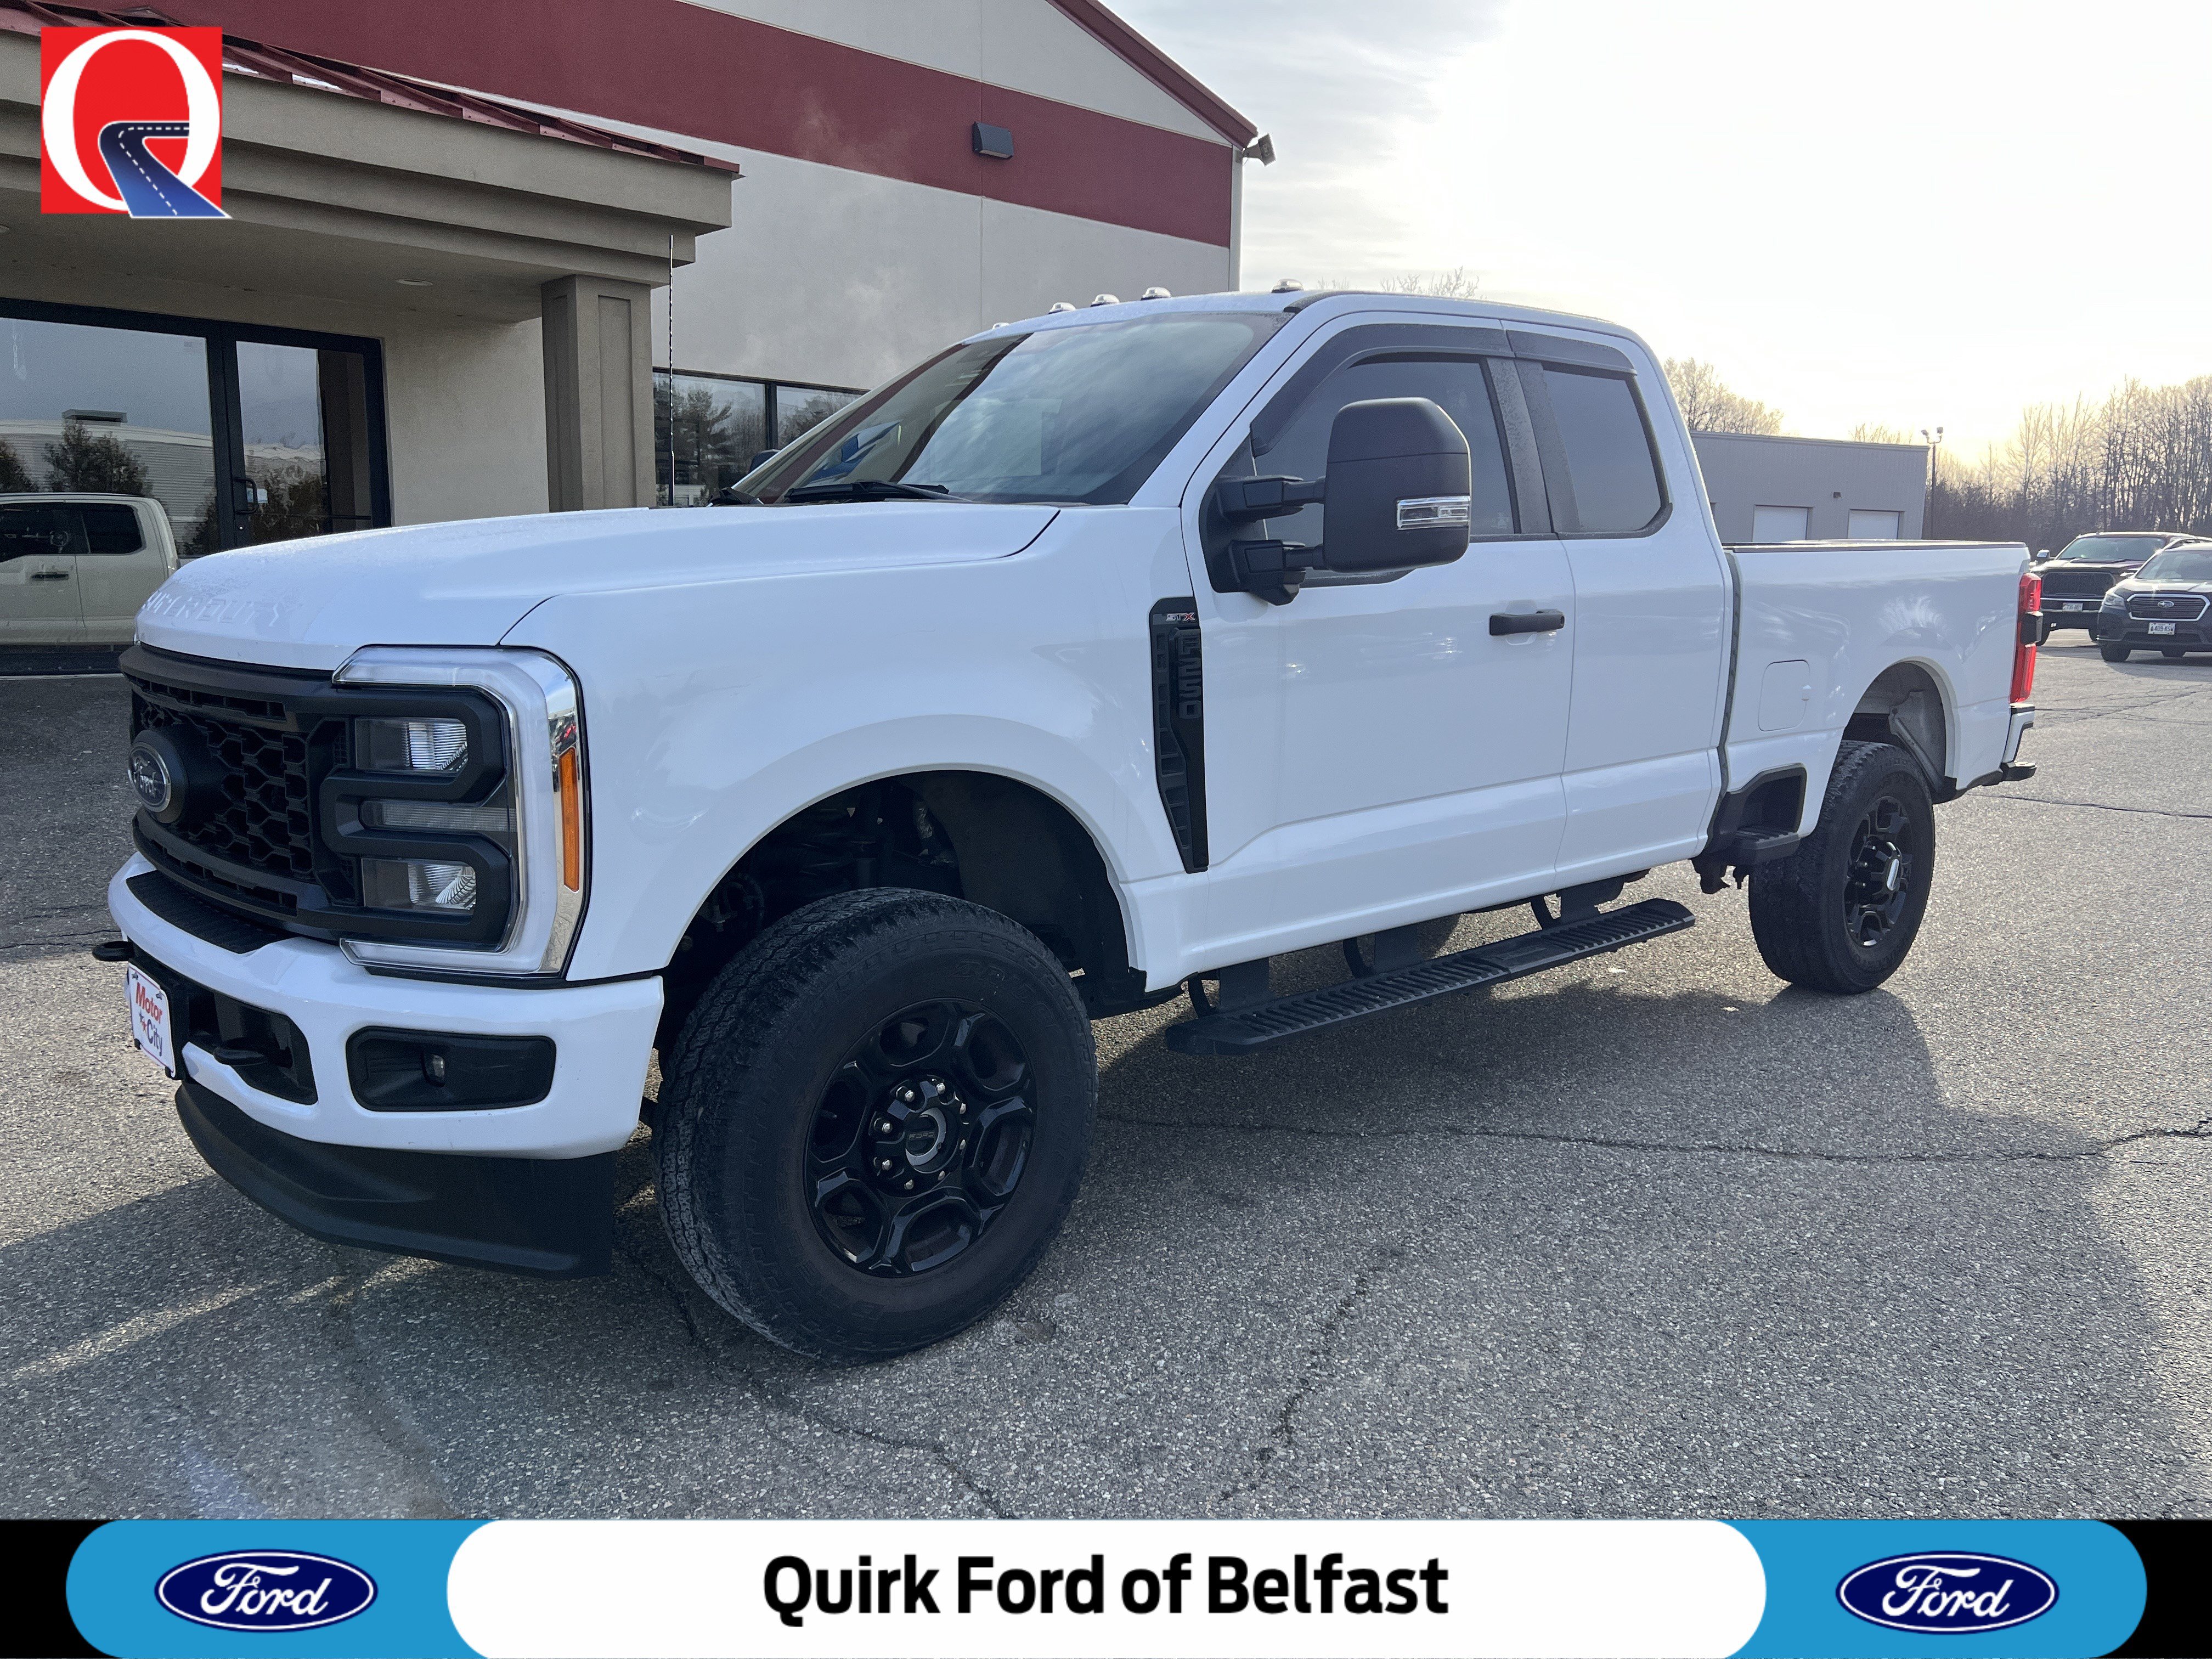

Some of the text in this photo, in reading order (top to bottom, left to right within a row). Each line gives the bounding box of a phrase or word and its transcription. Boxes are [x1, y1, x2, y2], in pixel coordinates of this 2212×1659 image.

[1166, 612, 1195, 622] STX
[136, 981, 163, 1024] Motor
[147, 1019, 162, 1057] City
